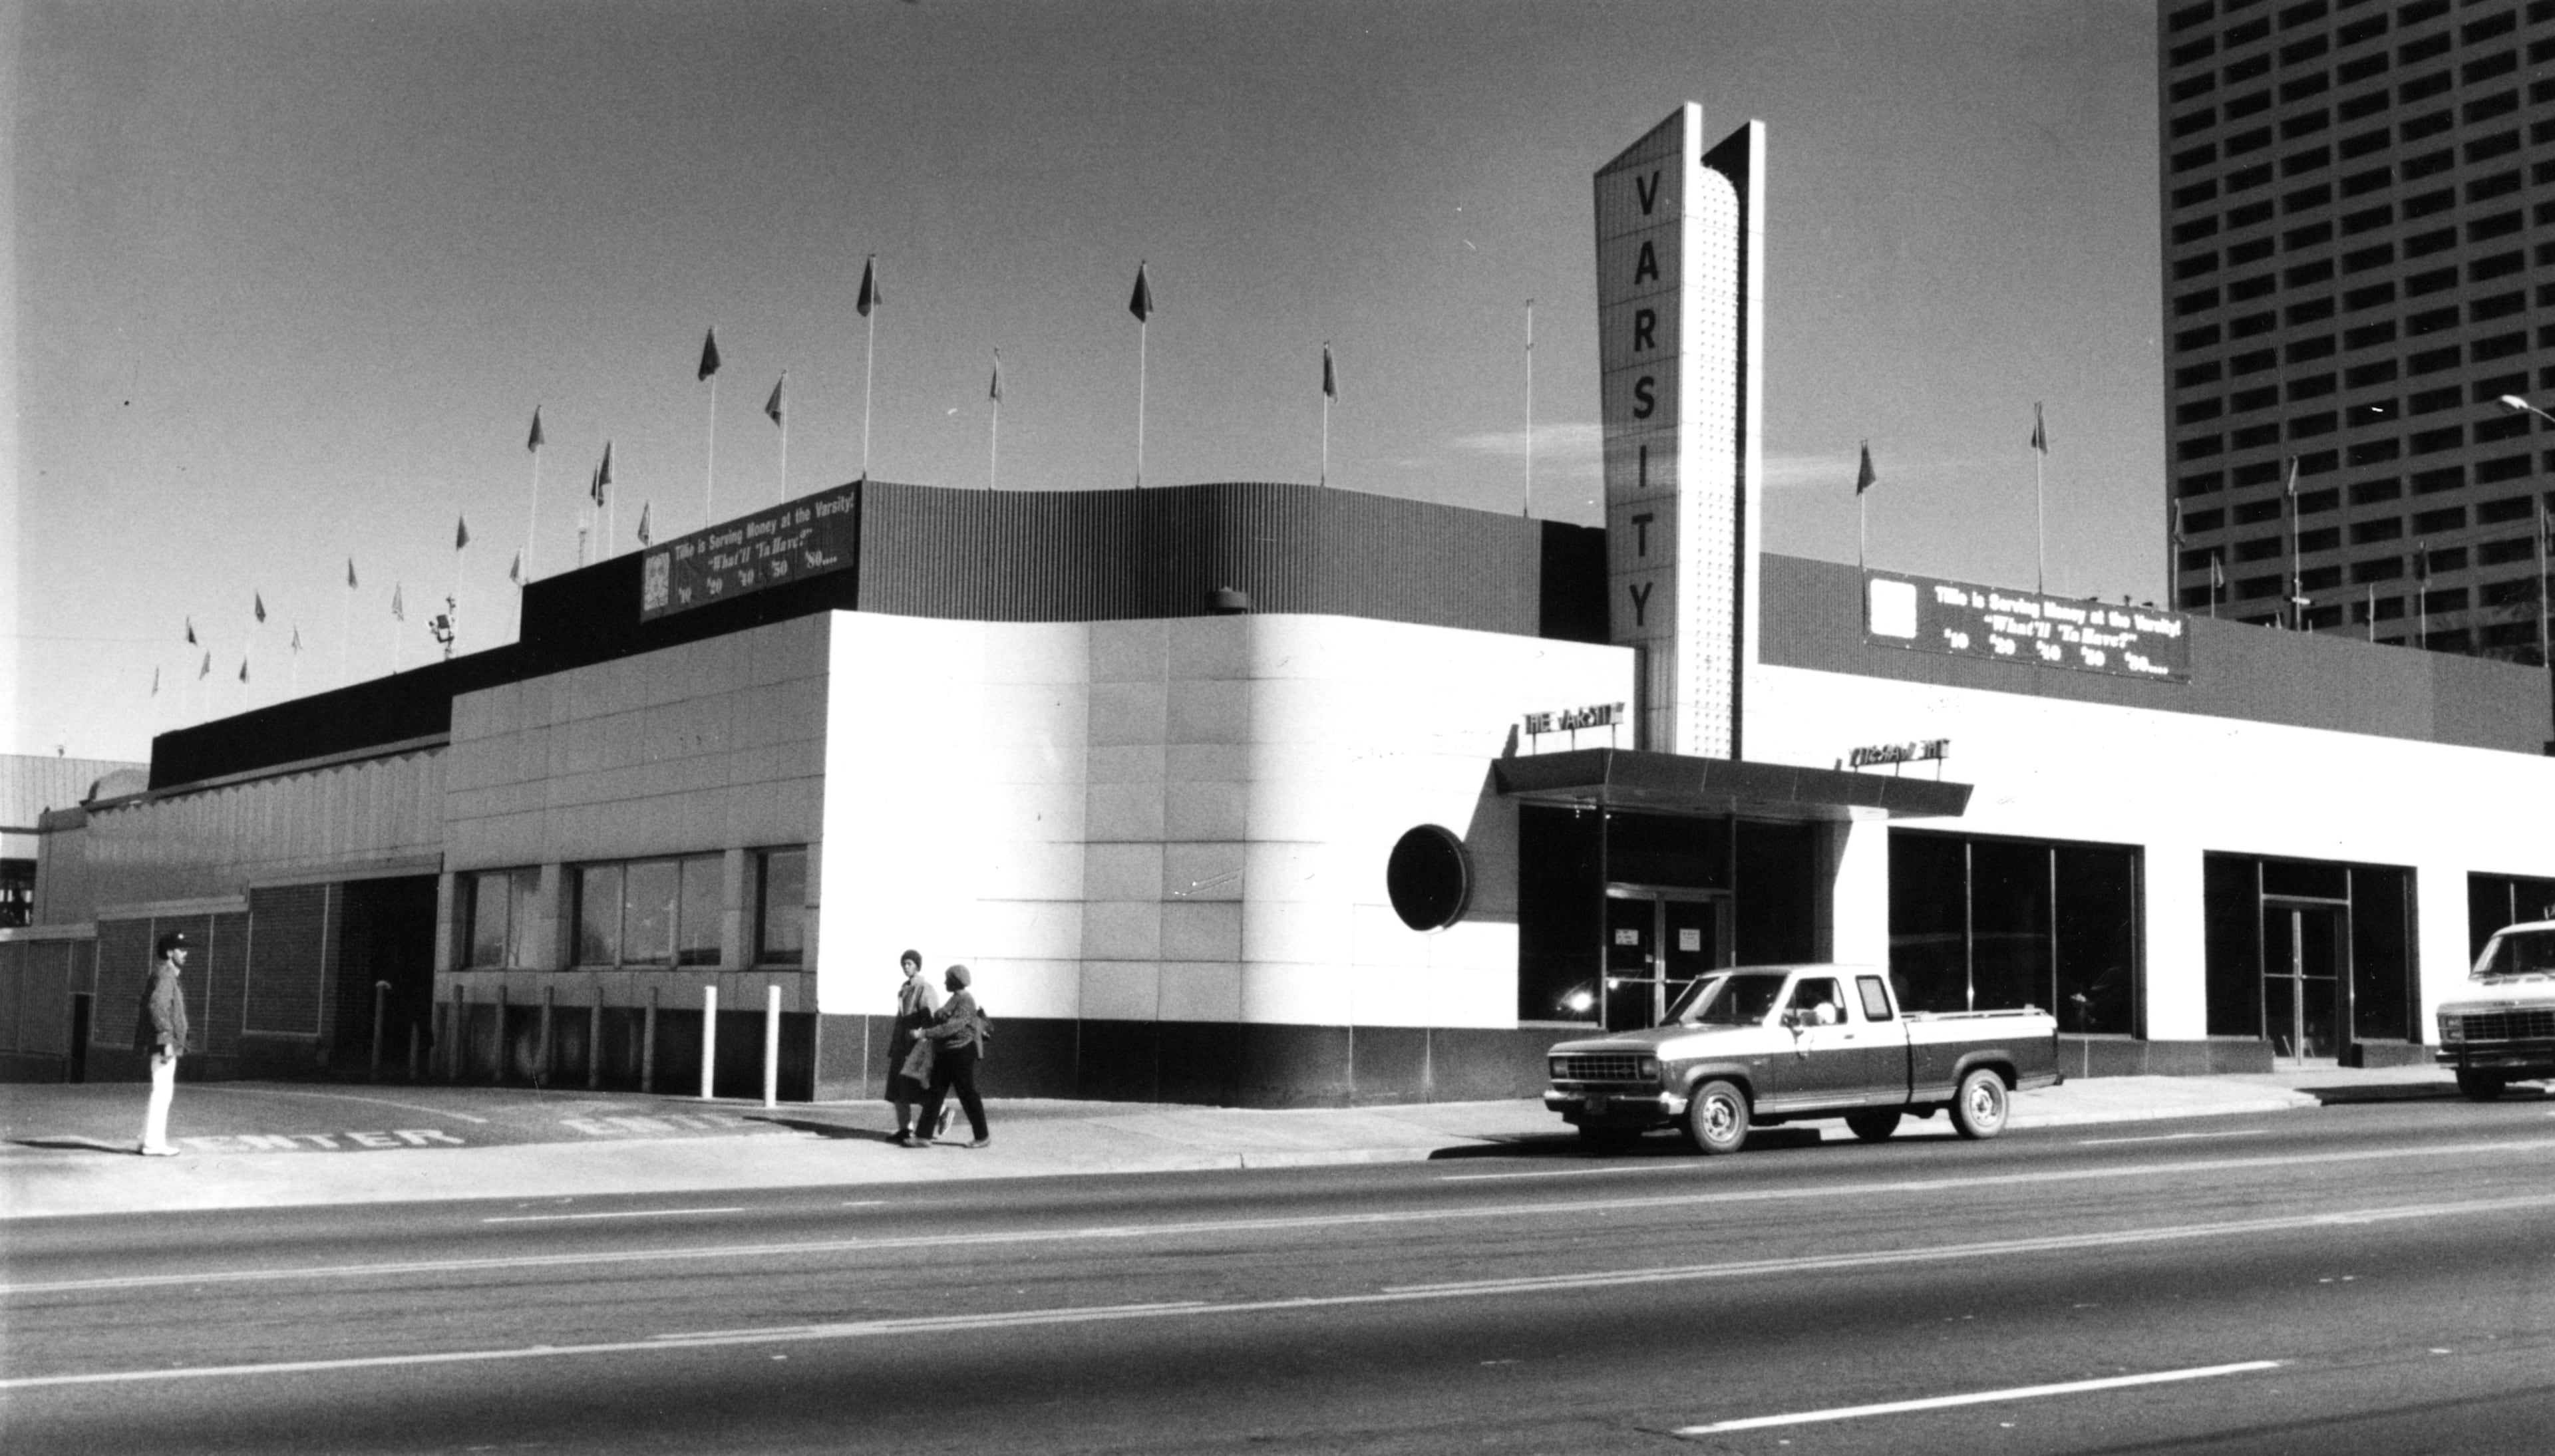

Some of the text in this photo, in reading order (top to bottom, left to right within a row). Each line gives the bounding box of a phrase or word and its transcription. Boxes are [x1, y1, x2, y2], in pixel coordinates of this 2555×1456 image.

[1628, 170, 1660, 627] VARSITY
[697, 539, 706, 554] is
[709, 529, 743, 550] Serving
[747, 519, 776, 539] Money
[781, 512, 791, 529] at
[795, 507, 811, 525] the
[815, 492, 855, 518] Varsity!
[1989, 593, 2041, 619] Serving
[2090, 609, 2106, 625] at
[2109, 611, 2132, 629] the
[2134, 614, 2182, 639] Varsity!
[178, 1129, 465, 1151] ENTER
